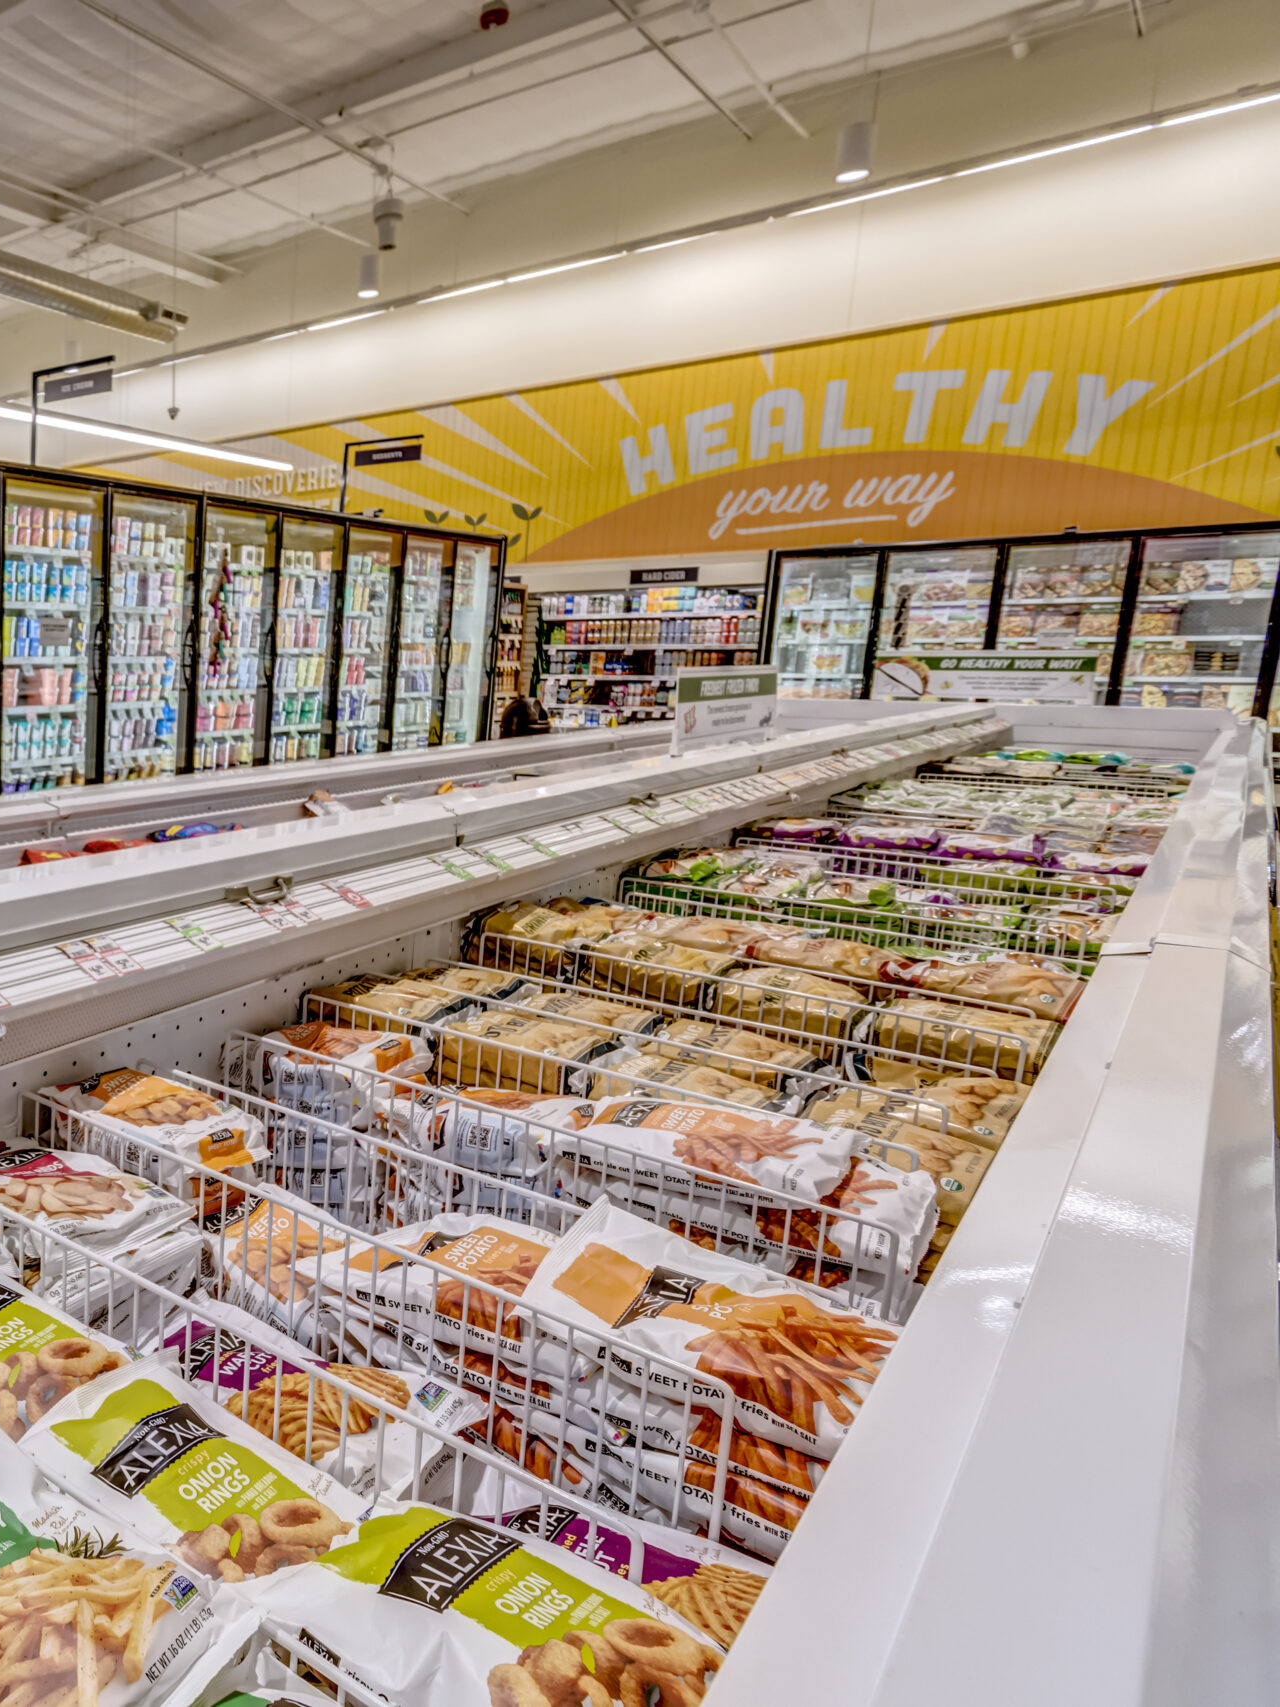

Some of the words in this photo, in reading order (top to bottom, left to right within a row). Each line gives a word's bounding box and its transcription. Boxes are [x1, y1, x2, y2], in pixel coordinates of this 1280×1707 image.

[619, 369, 1156, 497] HEALTHY
[708, 480, 830, 541] your
[843, 470, 955, 527] way
[940, 659, 956, 669] GO
[958, 659, 1012, 669] HEALTHY
[1014, 659, 1047, 669] YOUR
[1048, 658, 1084, 670] WAY!
[443, 1231, 483, 1263] SWEET
[455, 1233, 500, 1272] POTATO
[132, 1415, 167, 1444] Non-GMO
[740, 1400, 771, 1421] fries
[800, 1429, 818, 1446] SALT
[120, 1417, 214, 1488] ALEXIA
[177, 1448, 211, 1477] crispy
[177, 1451, 241, 1501] ONION
[197, 1467, 252, 1515] RINGS
[732, 1464, 763, 1484] fries
[730, 1506, 762, 1531] fries
[418, 1530, 450, 1557] Non-GMO
[414, 1529, 512, 1602] ALEXIA
[484, 1568, 517, 1593] crispy
[494, 1571, 553, 1616] ONION
[520, 1587, 577, 1631] RINGS
[145, 1663, 161, 1684] NET
[156, 1654, 171, 1673] WT
[167, 1646, 180, 1661] 16
[174, 1633, 188, 1653] OZ
[189, 1616, 205, 1638] LB)
[299, 1634, 339, 1667] ALEXIA
